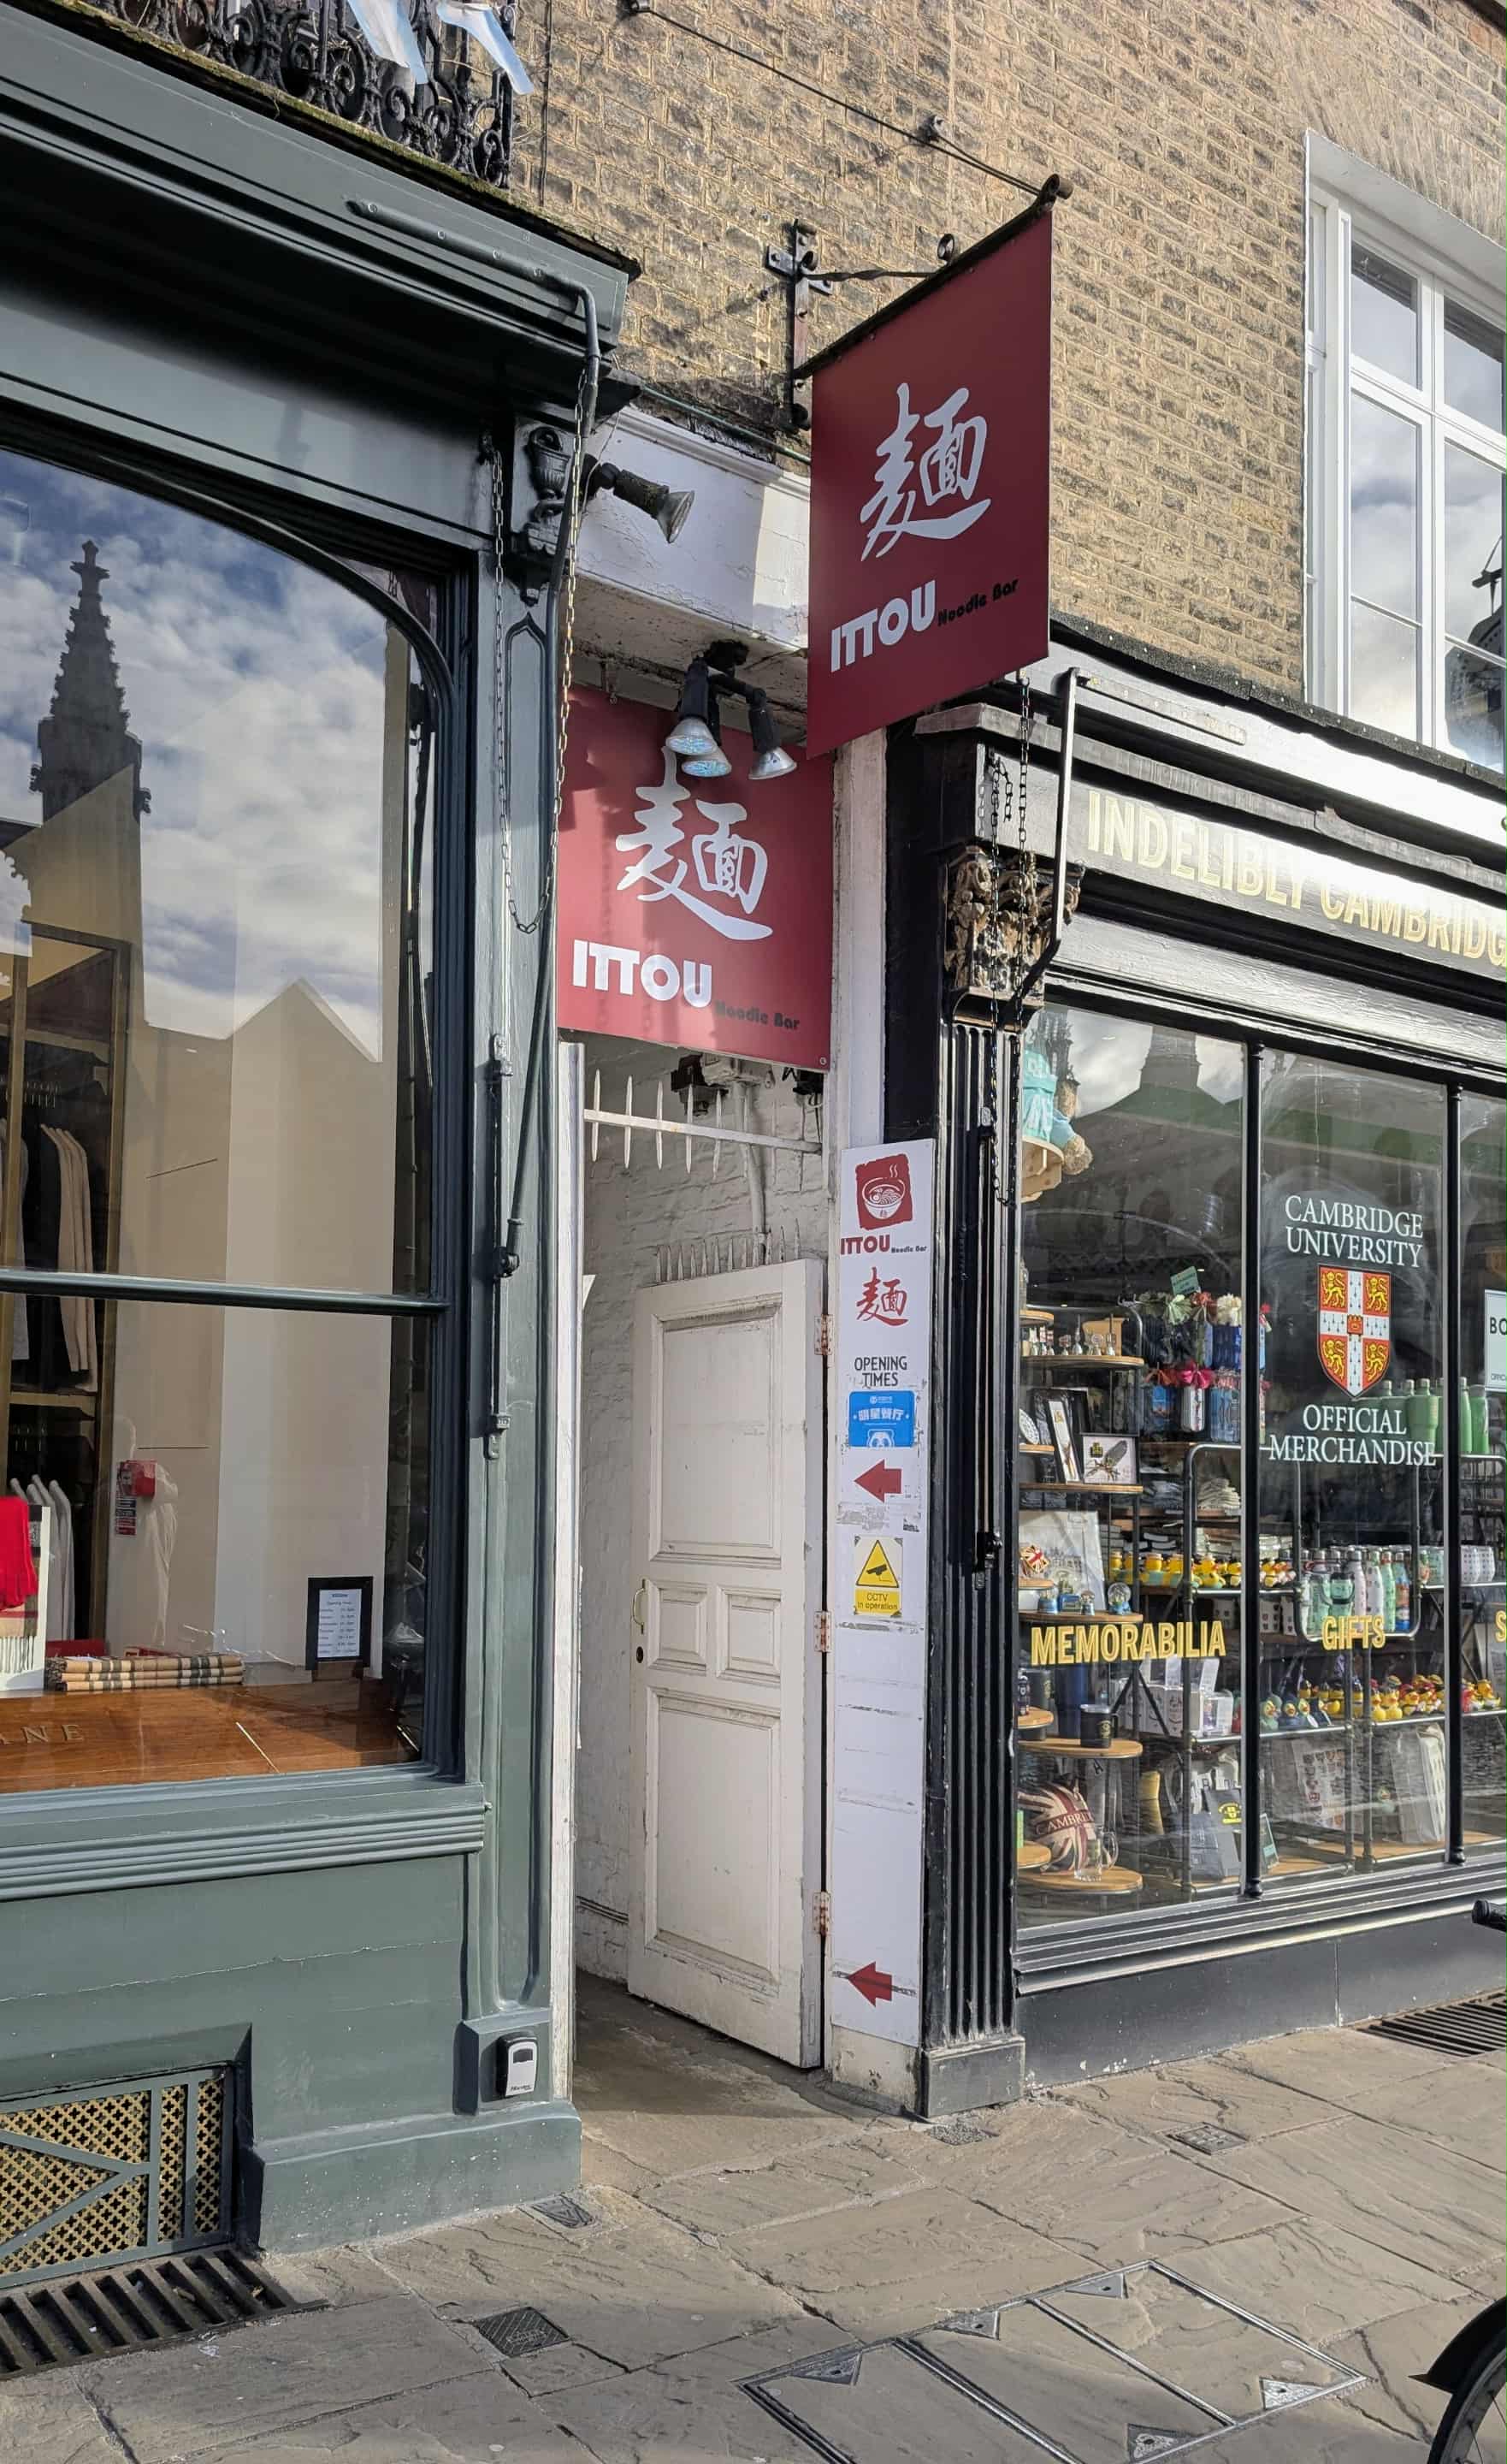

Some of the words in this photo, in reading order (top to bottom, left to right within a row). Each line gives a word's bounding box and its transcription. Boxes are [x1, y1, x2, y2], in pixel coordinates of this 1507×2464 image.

[830, 579, 936, 673] ITTOU
[937, 594, 988, 626] Noodle
[992, 579, 1019, 601] Bar
[573, 939, 712, 1008] ITTOU
[714, 1000, 769, 1027] Noodle
[774, 1010, 801, 1031] Bar
[1285, 1195, 1424, 1239] CAMBRIDGE
[840, 1235, 890, 1255] ITTOU
[1285, 1226, 1424, 1268] UNIVERSITY
[854, 1355, 907, 1372] OPENING
[862, 1372, 899, 1388] TIMES
[1303, 1404, 1407, 1435] OFFICIAL
[1268, 1434, 1437, 1466] MERCHANDISE
[865, 1601, 898, 1611] operation
[866, 1592, 889, 1602] CCTV
[1031, 1620, 1226, 1666] MEMORABILIA
[1321, 1615, 1386, 1650] GIFTS
